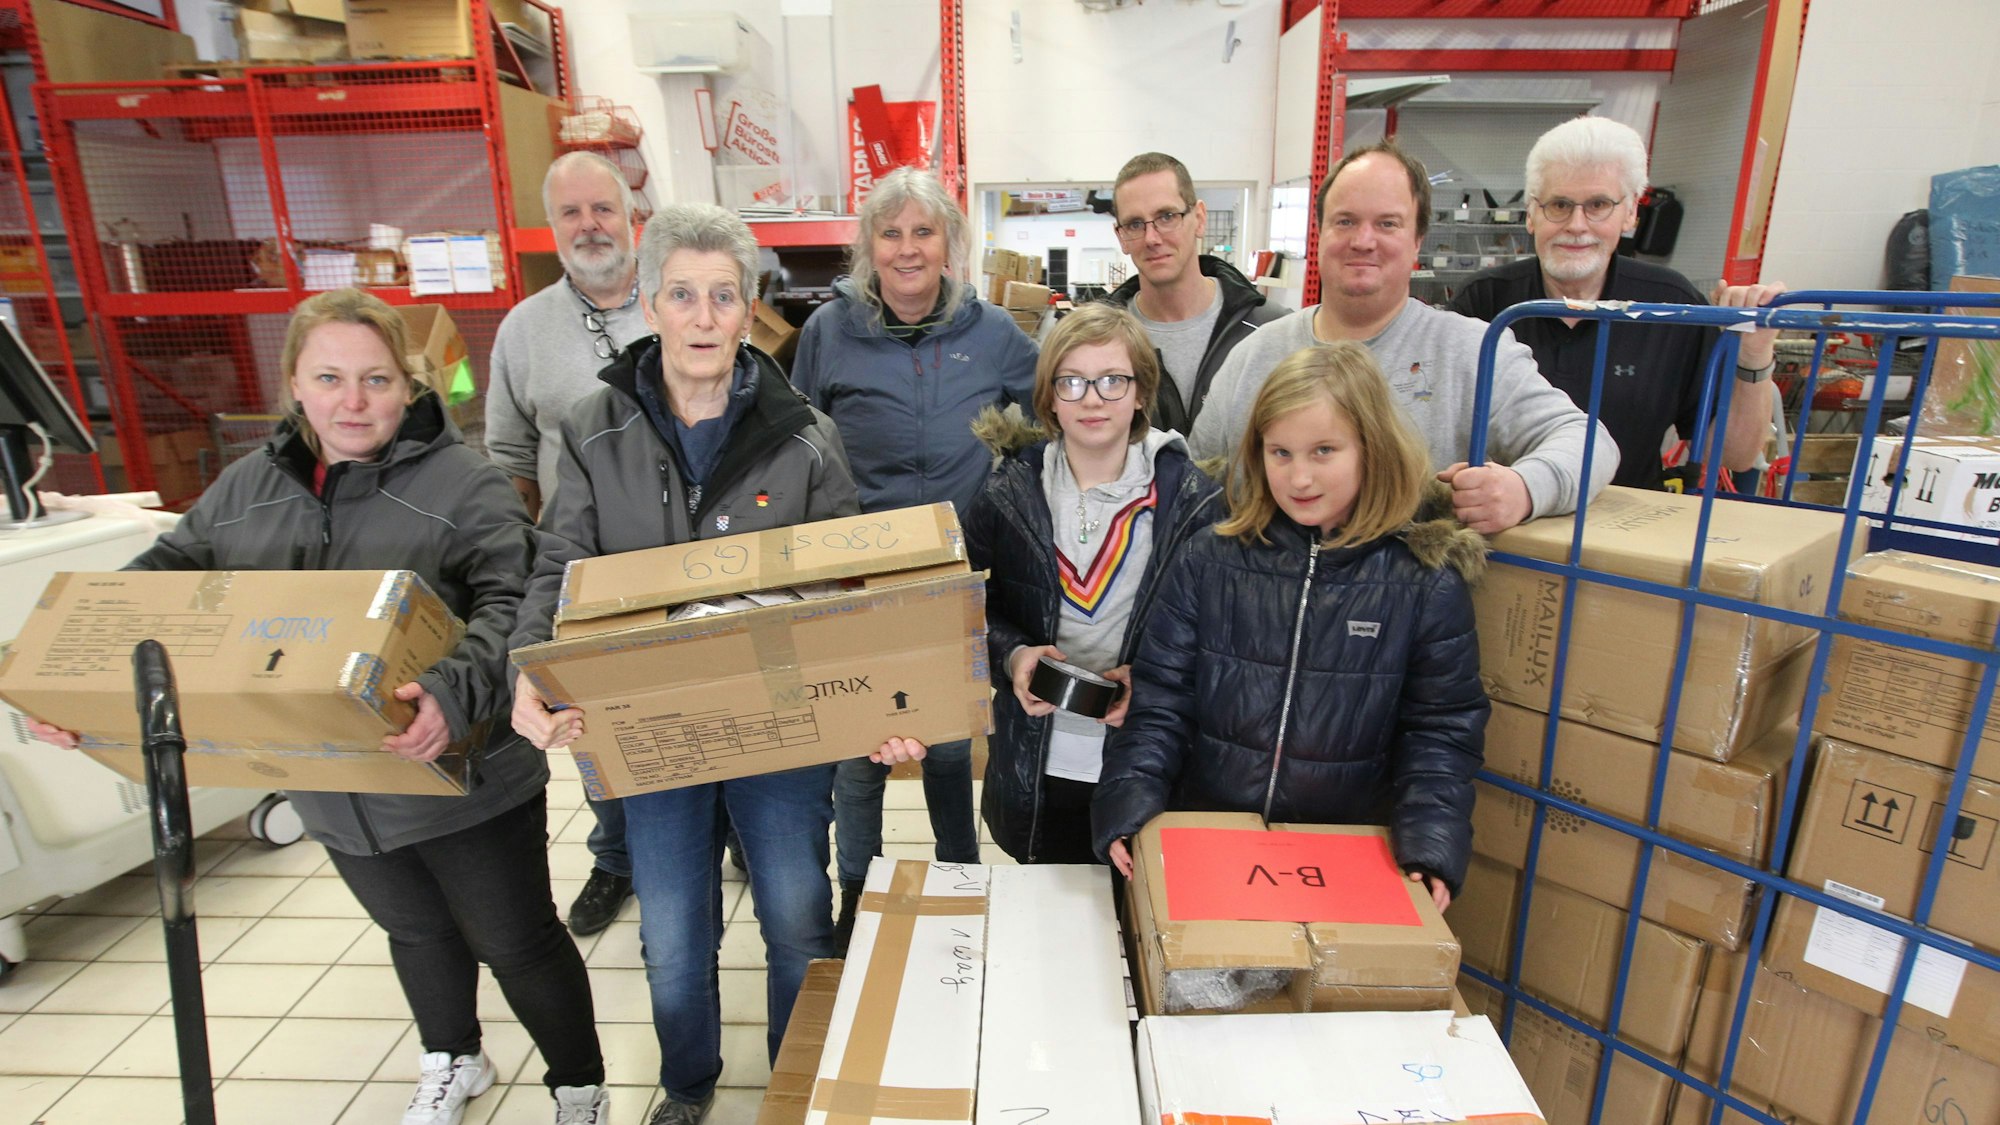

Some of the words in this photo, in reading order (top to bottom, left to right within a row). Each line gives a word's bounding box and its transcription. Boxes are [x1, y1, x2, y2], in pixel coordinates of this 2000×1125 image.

[737, 113, 777, 146] Große
[822, 521, 898, 550] 280
[1528, 580, 1560, 687] MAILUX
[1246, 864, 1326, 887] B-V
